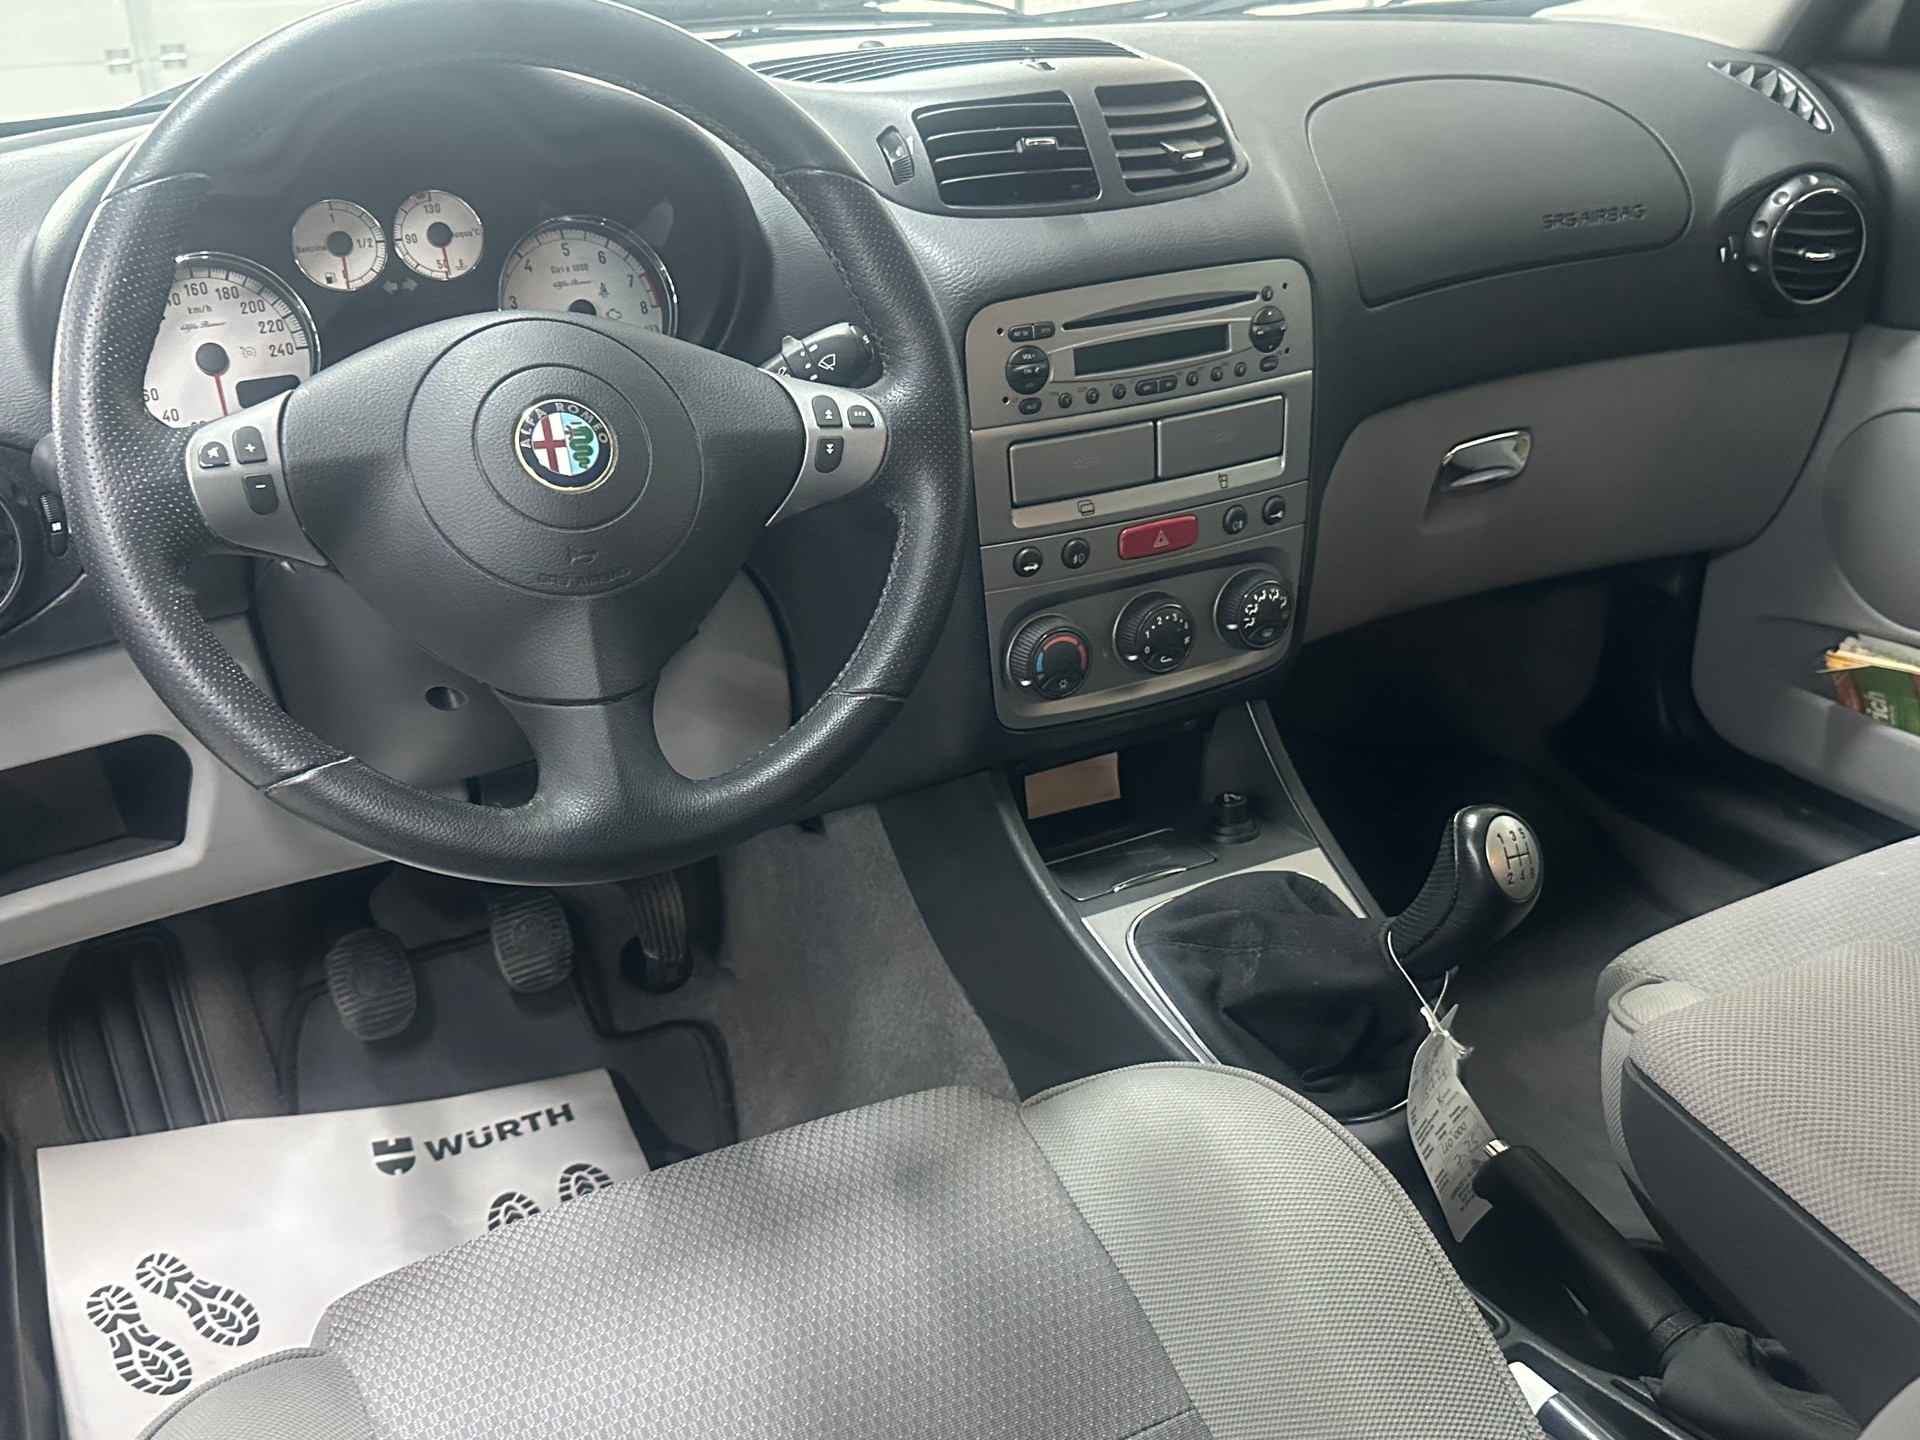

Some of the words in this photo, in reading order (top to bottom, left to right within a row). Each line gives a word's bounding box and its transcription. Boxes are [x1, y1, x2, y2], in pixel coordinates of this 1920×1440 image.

[424, 203, 441, 215] 130
[329, 213, 335, 223] 1
[356, 237, 373, 249] 1/2
[405, 233, 418, 244] 90
[561, 243, 570, 257] 5
[598, 251, 607, 265] 6
[524, 259, 533, 273] 4
[573, 263, 589, 272] 1000
[627, 274, 634, 288] 7
[183, 281, 208, 297] 160
[215, 285, 240, 301] 180
[240, 300, 266, 315] 200
[509, 295, 518, 310] 3
[640, 301, 648, 315] 8
[188, 305, 212, 315] km/h
[258, 318, 284, 334] 220
[269, 342, 294, 358] 240
[143, 388, 159, 401] 60
[162, 408, 180, 422] 40
[520, 407, 548, 449] ALFA
[555, 402, 609, 444] ROMEO
[1156, 616, 1163, 625] 2
[1145, 630, 1150, 639] 1
[1144, 646, 1150, 654] 0
[1496, 833, 1505, 844] 1
[1509, 830, 1517, 841] 3
[1518, 828, 1526, 839] 5
[1507, 872, 1514, 885] 2
[424, 1103, 575, 1161] WÜRTH
